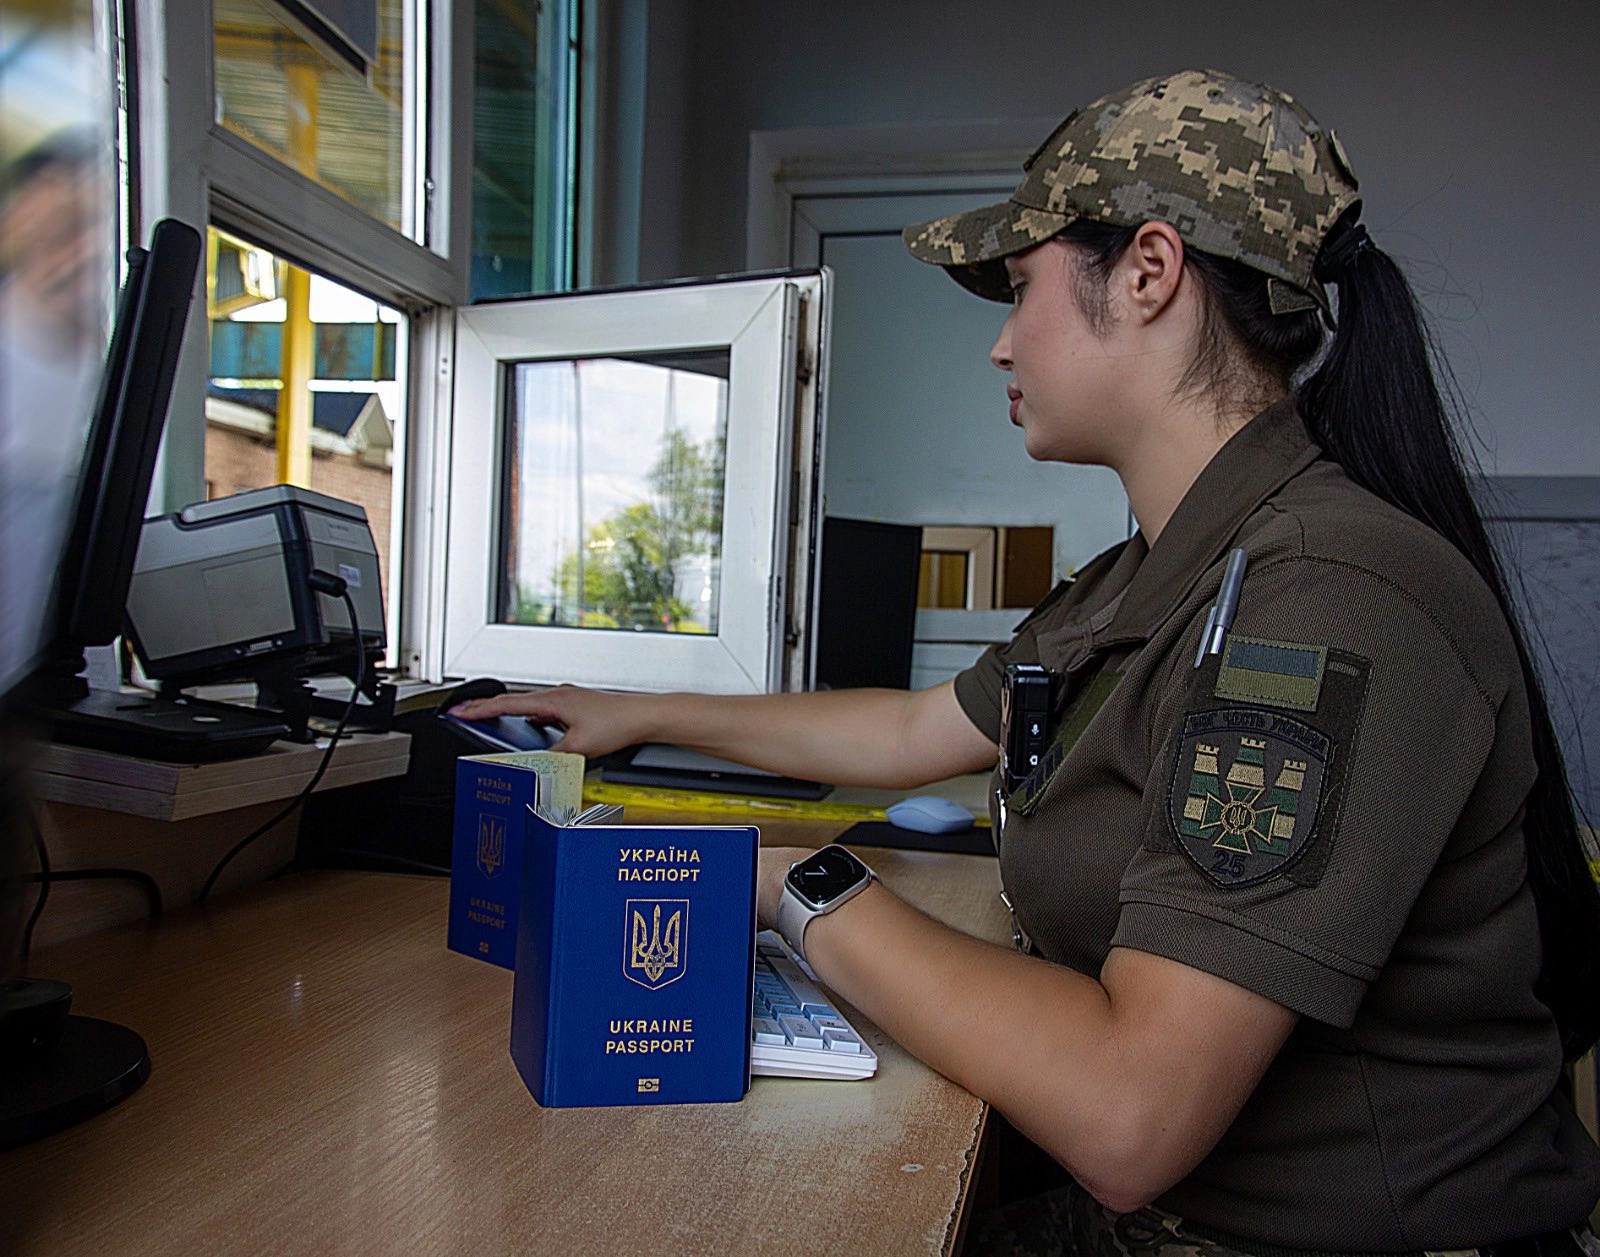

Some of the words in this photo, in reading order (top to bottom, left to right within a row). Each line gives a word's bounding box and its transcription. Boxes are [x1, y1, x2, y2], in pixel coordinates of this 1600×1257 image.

[1222, 711, 1265, 728] ЧЕСТЬ
[619, 846, 701, 862] УКРАЇНА
[1210, 850, 1246, 878] 25
[618, 868, 701, 882] ПАСПОРТ
[609, 1019, 694, 1034] UKRAINE
[605, 1039, 696, 1054] PASSPORT
